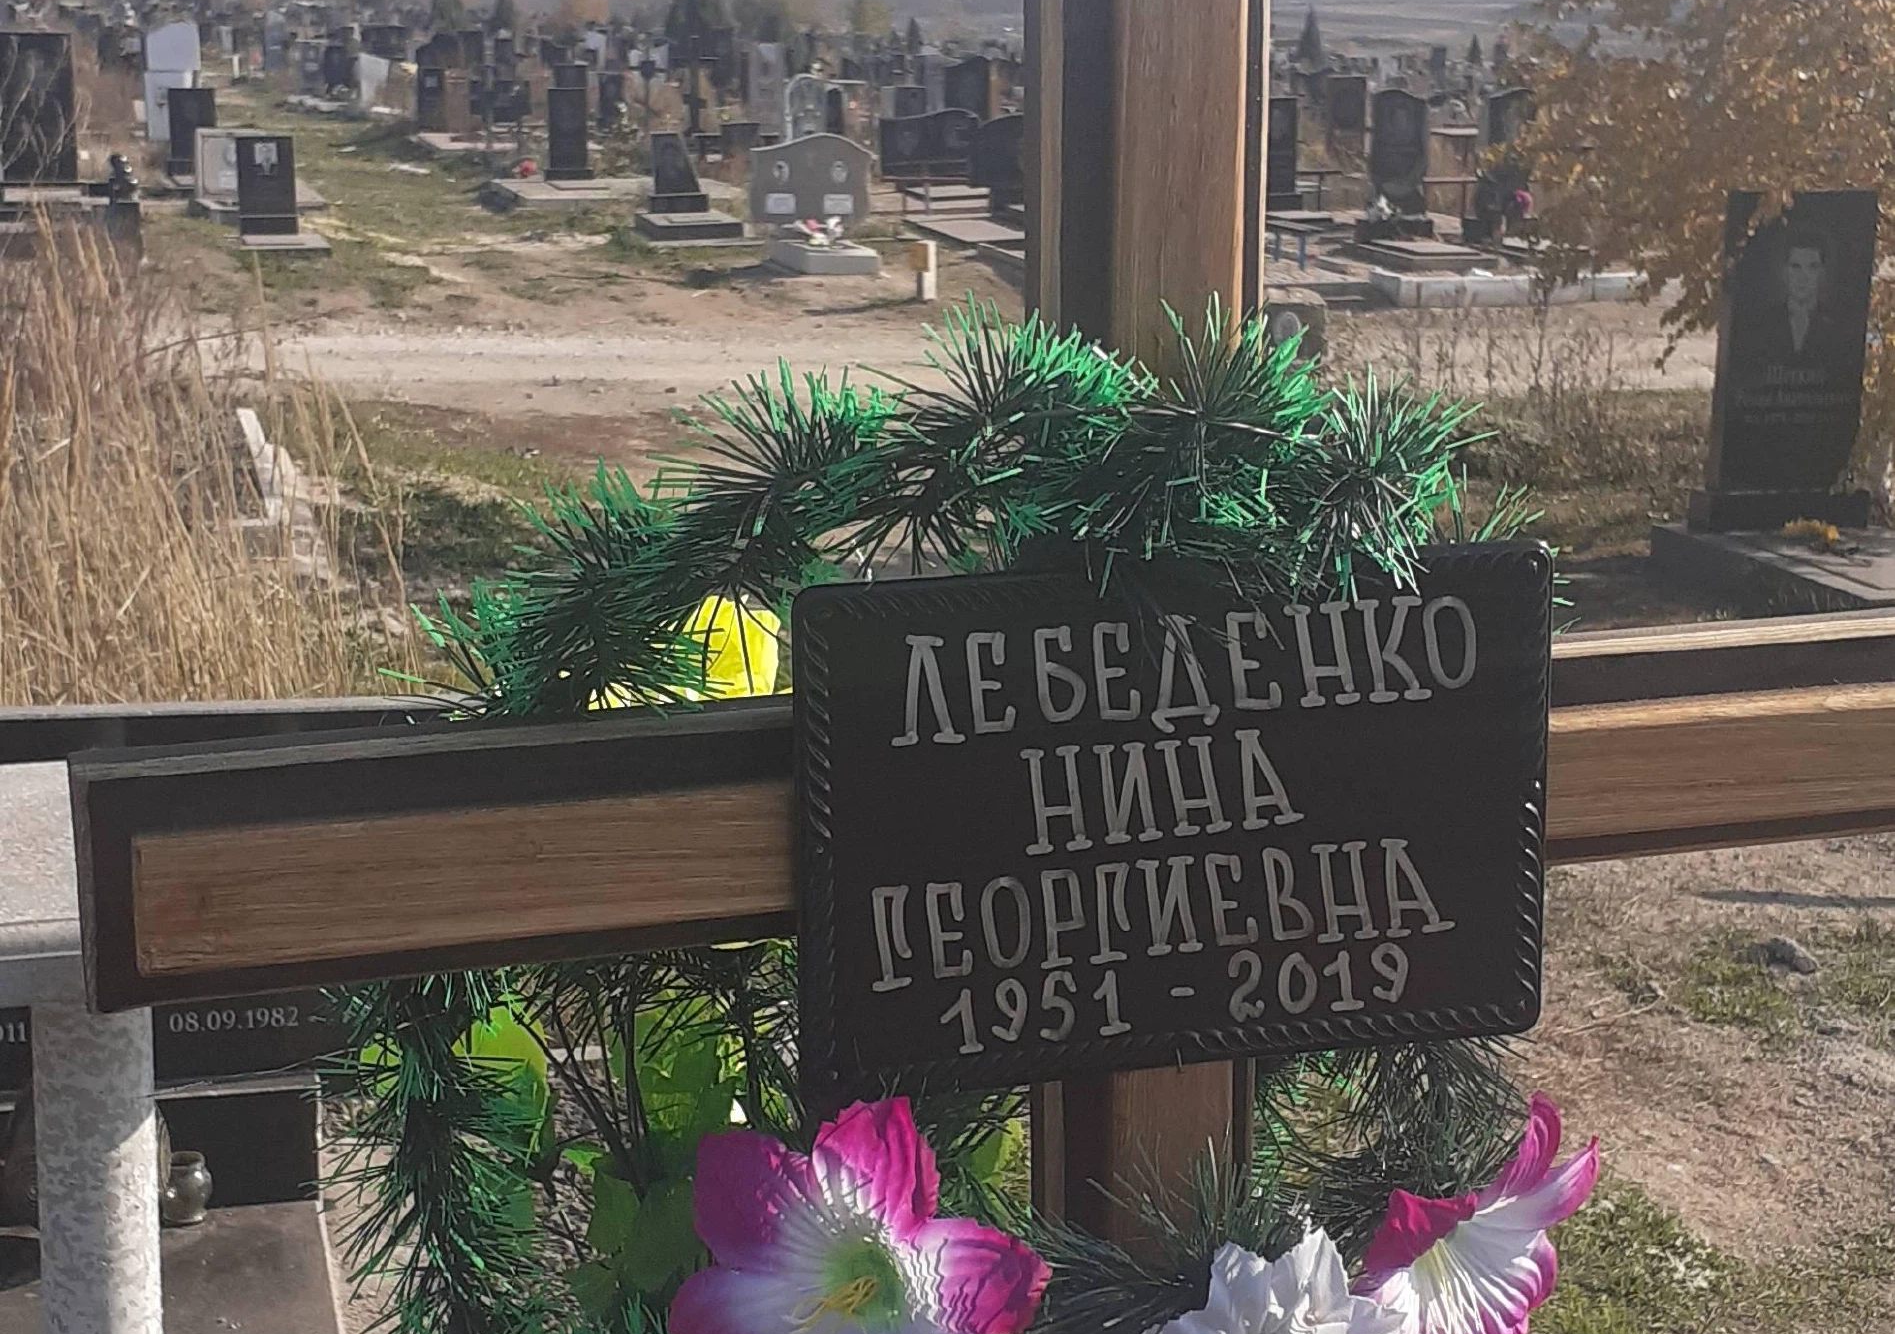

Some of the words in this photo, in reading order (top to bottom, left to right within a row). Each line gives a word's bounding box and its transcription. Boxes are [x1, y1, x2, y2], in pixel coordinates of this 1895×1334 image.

[891, 594, 1477, 746] ЛЕБЕДЕНКО
[1020, 728, 1304, 855] НИНА
[871, 838, 1456, 993] ГЕОРГИЕВНА
[169, 1007, 300, 1032] 08.09.1982
[940, 969, 1132, 1055] 1951
[1226, 943, 1410, 1022] 2019
